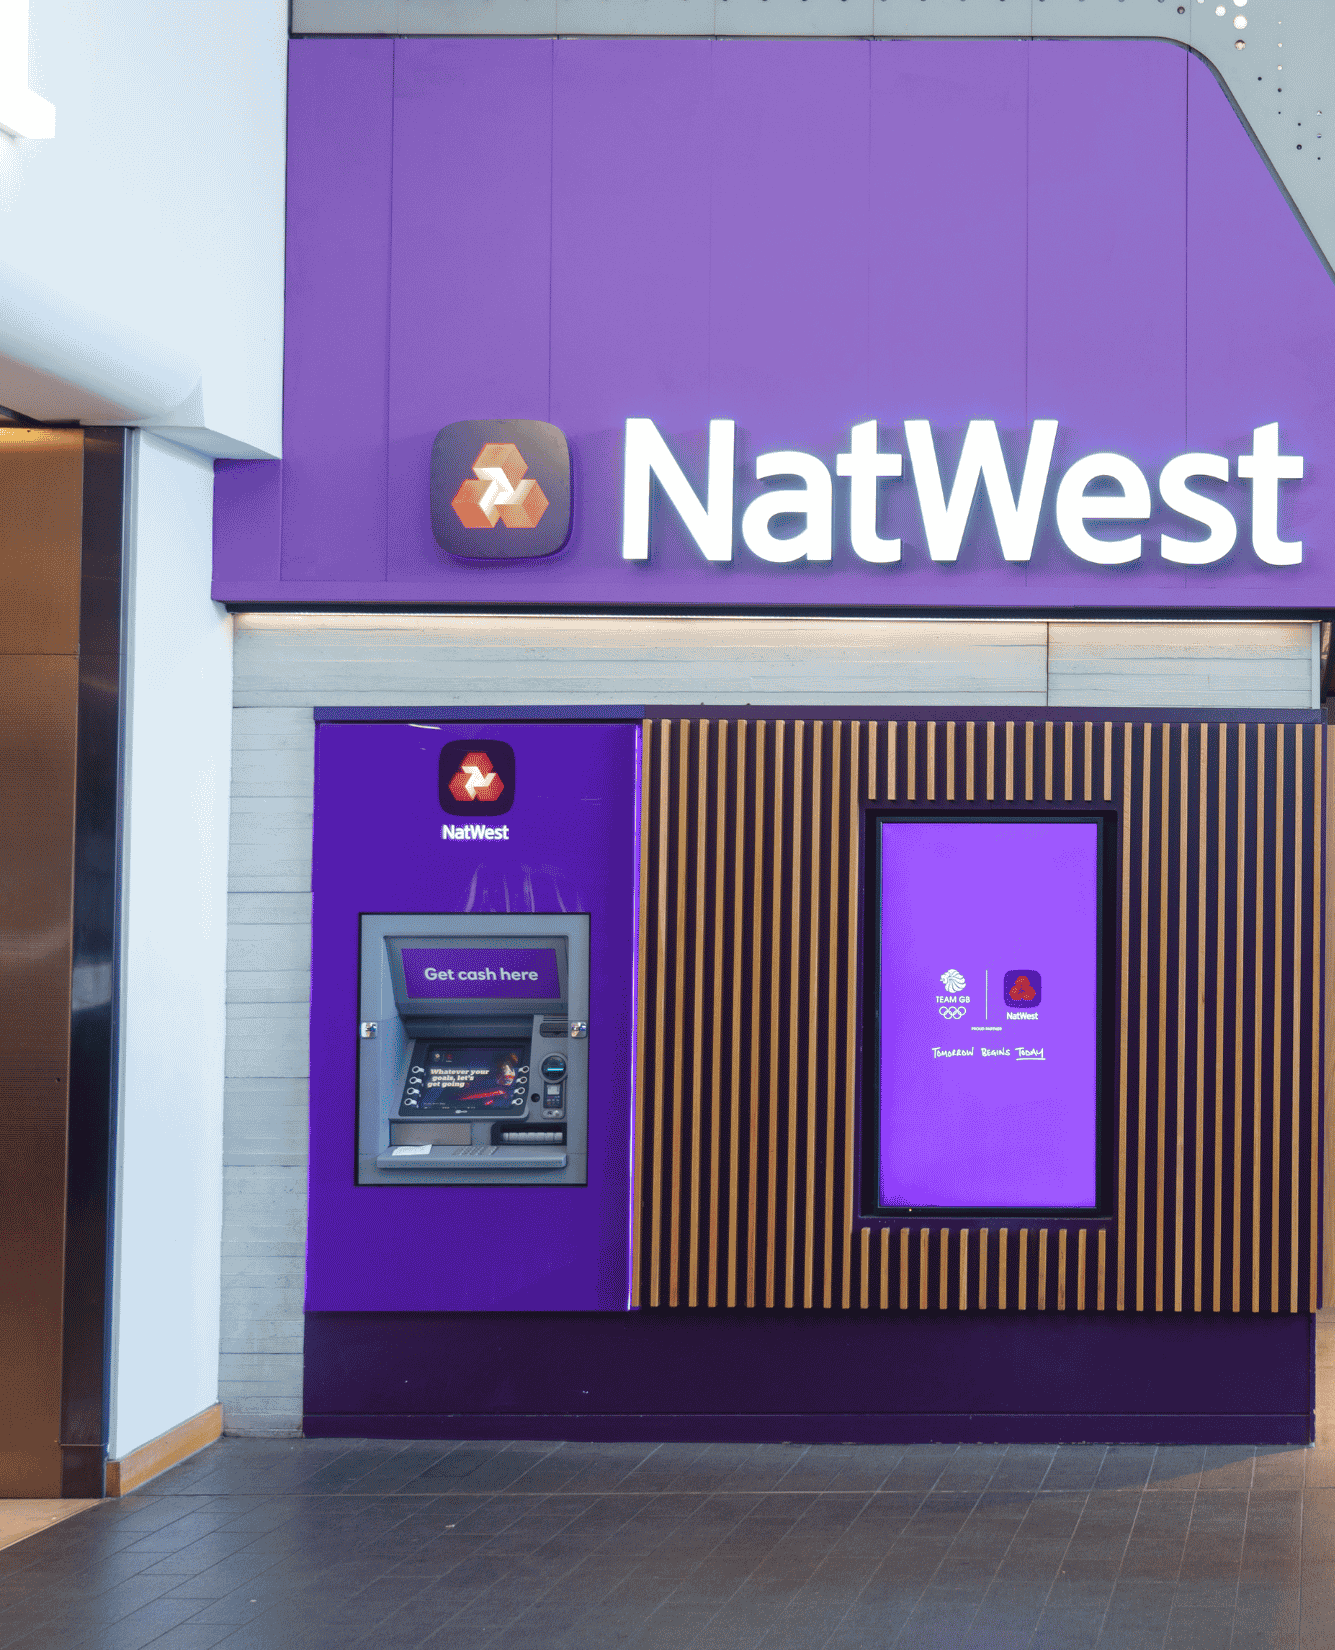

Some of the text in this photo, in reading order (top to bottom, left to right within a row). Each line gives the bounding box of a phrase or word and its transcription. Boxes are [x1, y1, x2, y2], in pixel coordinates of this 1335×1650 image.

[622, 417, 1305, 566] NatWest
[441, 824, 510, 840] NatWest
[424, 967, 539, 981] Get cash here
[936, 995, 971, 1003] TEAM GB
[1006, 1012, 1039, 1020] NatWest
[931, 1046, 1044, 1059] TOMORROW BEGINS TODAY
